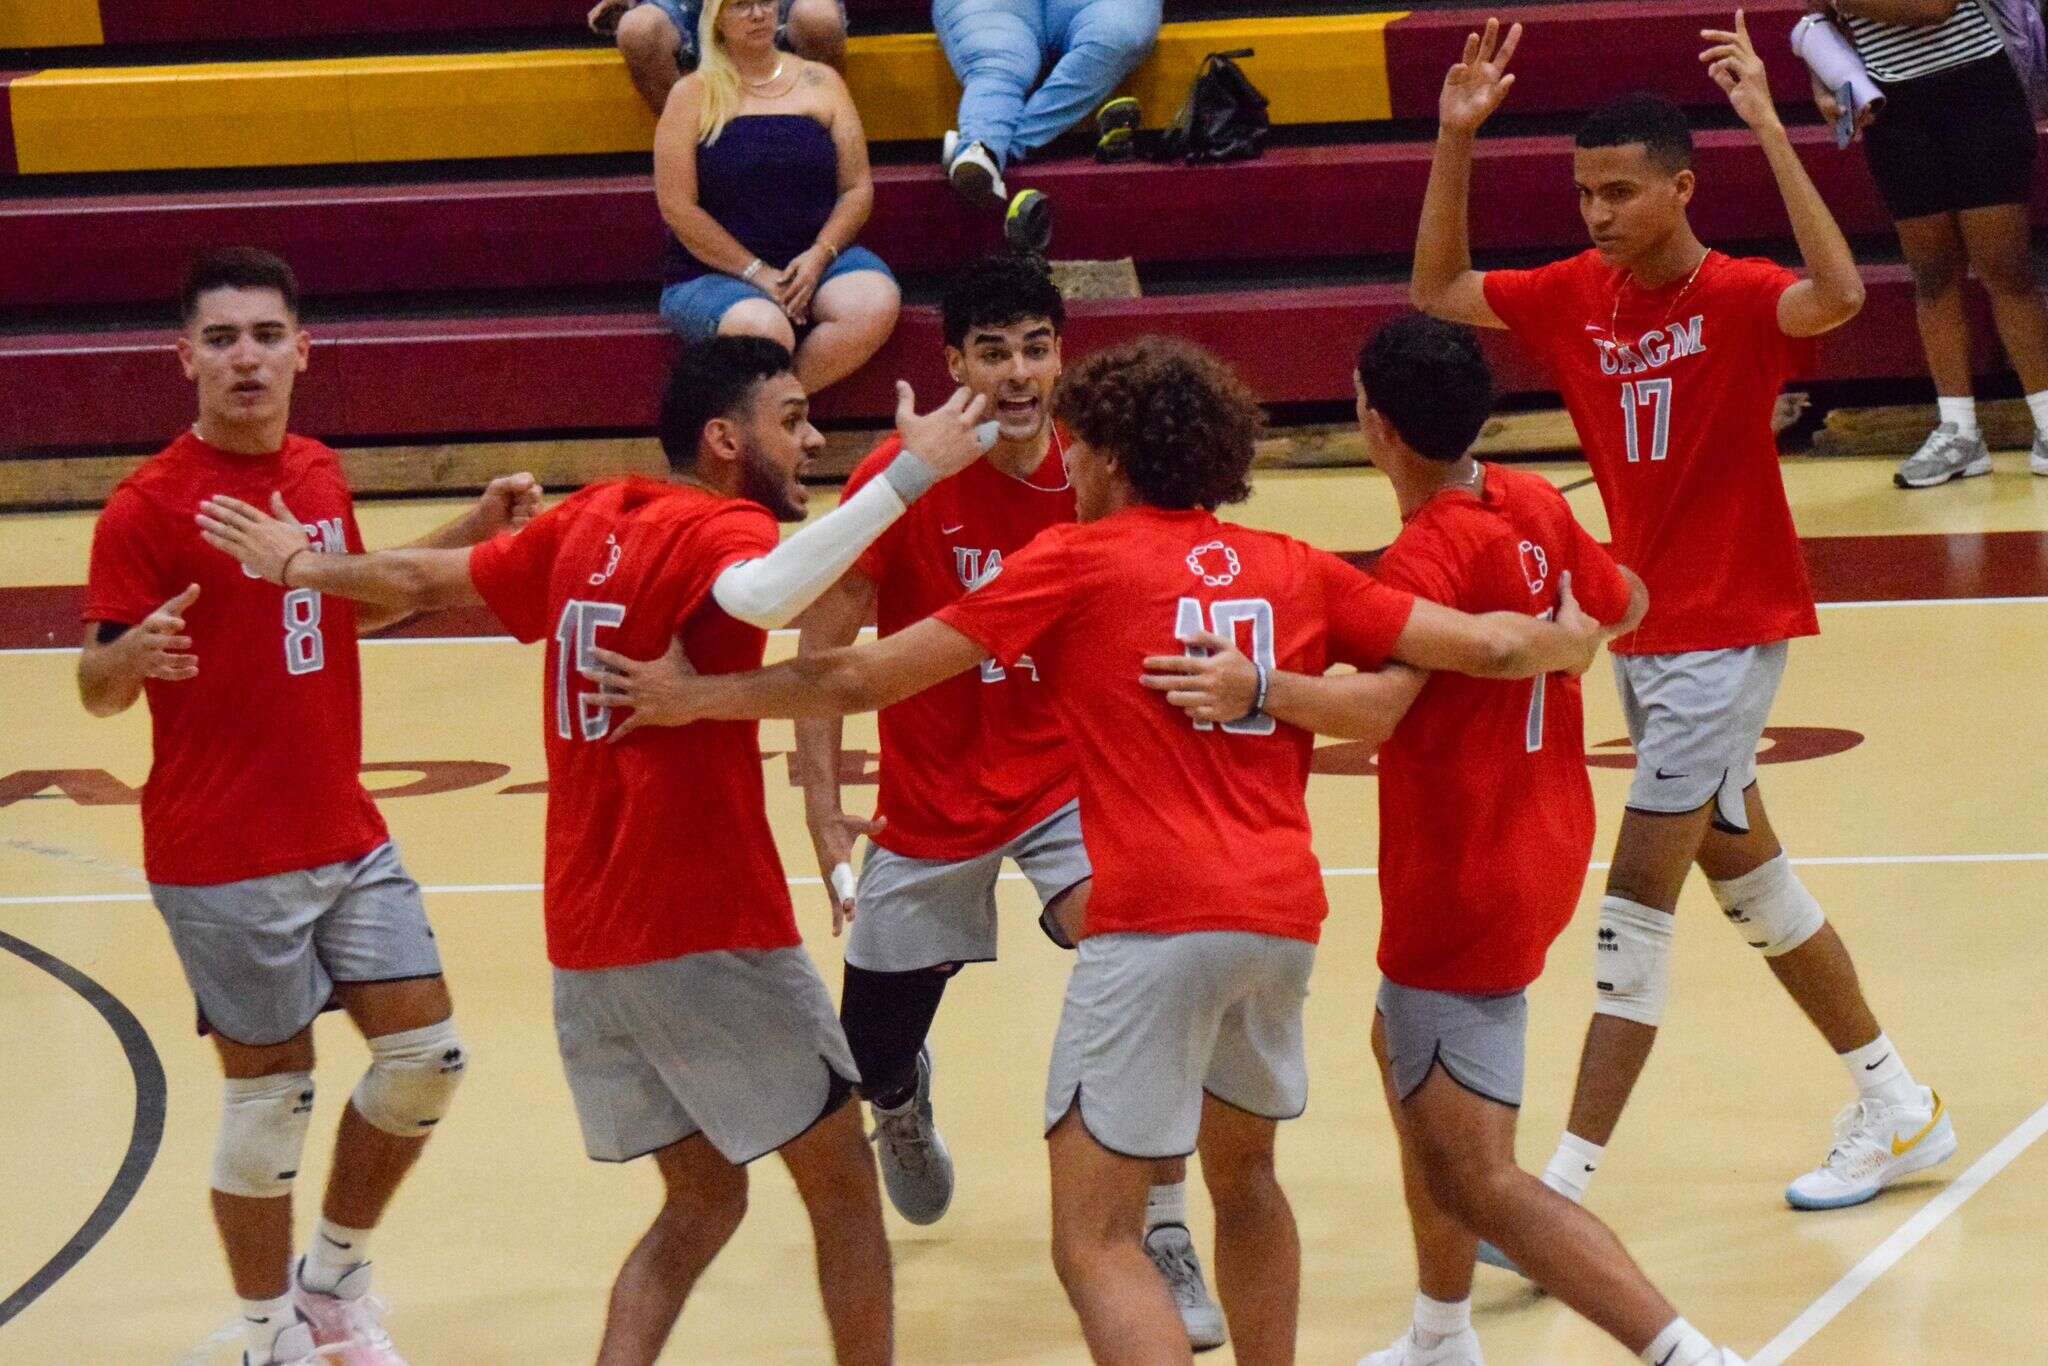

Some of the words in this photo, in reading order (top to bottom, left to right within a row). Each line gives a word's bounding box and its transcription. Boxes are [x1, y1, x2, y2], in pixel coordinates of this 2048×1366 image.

[1593, 315, 1706, 375] UAGM
[1620, 378, 1672, 462] 17
[284, 588, 324, 675] 8
[556, 599, 626, 741] 15
[1175, 597, 1276, 735] 10
